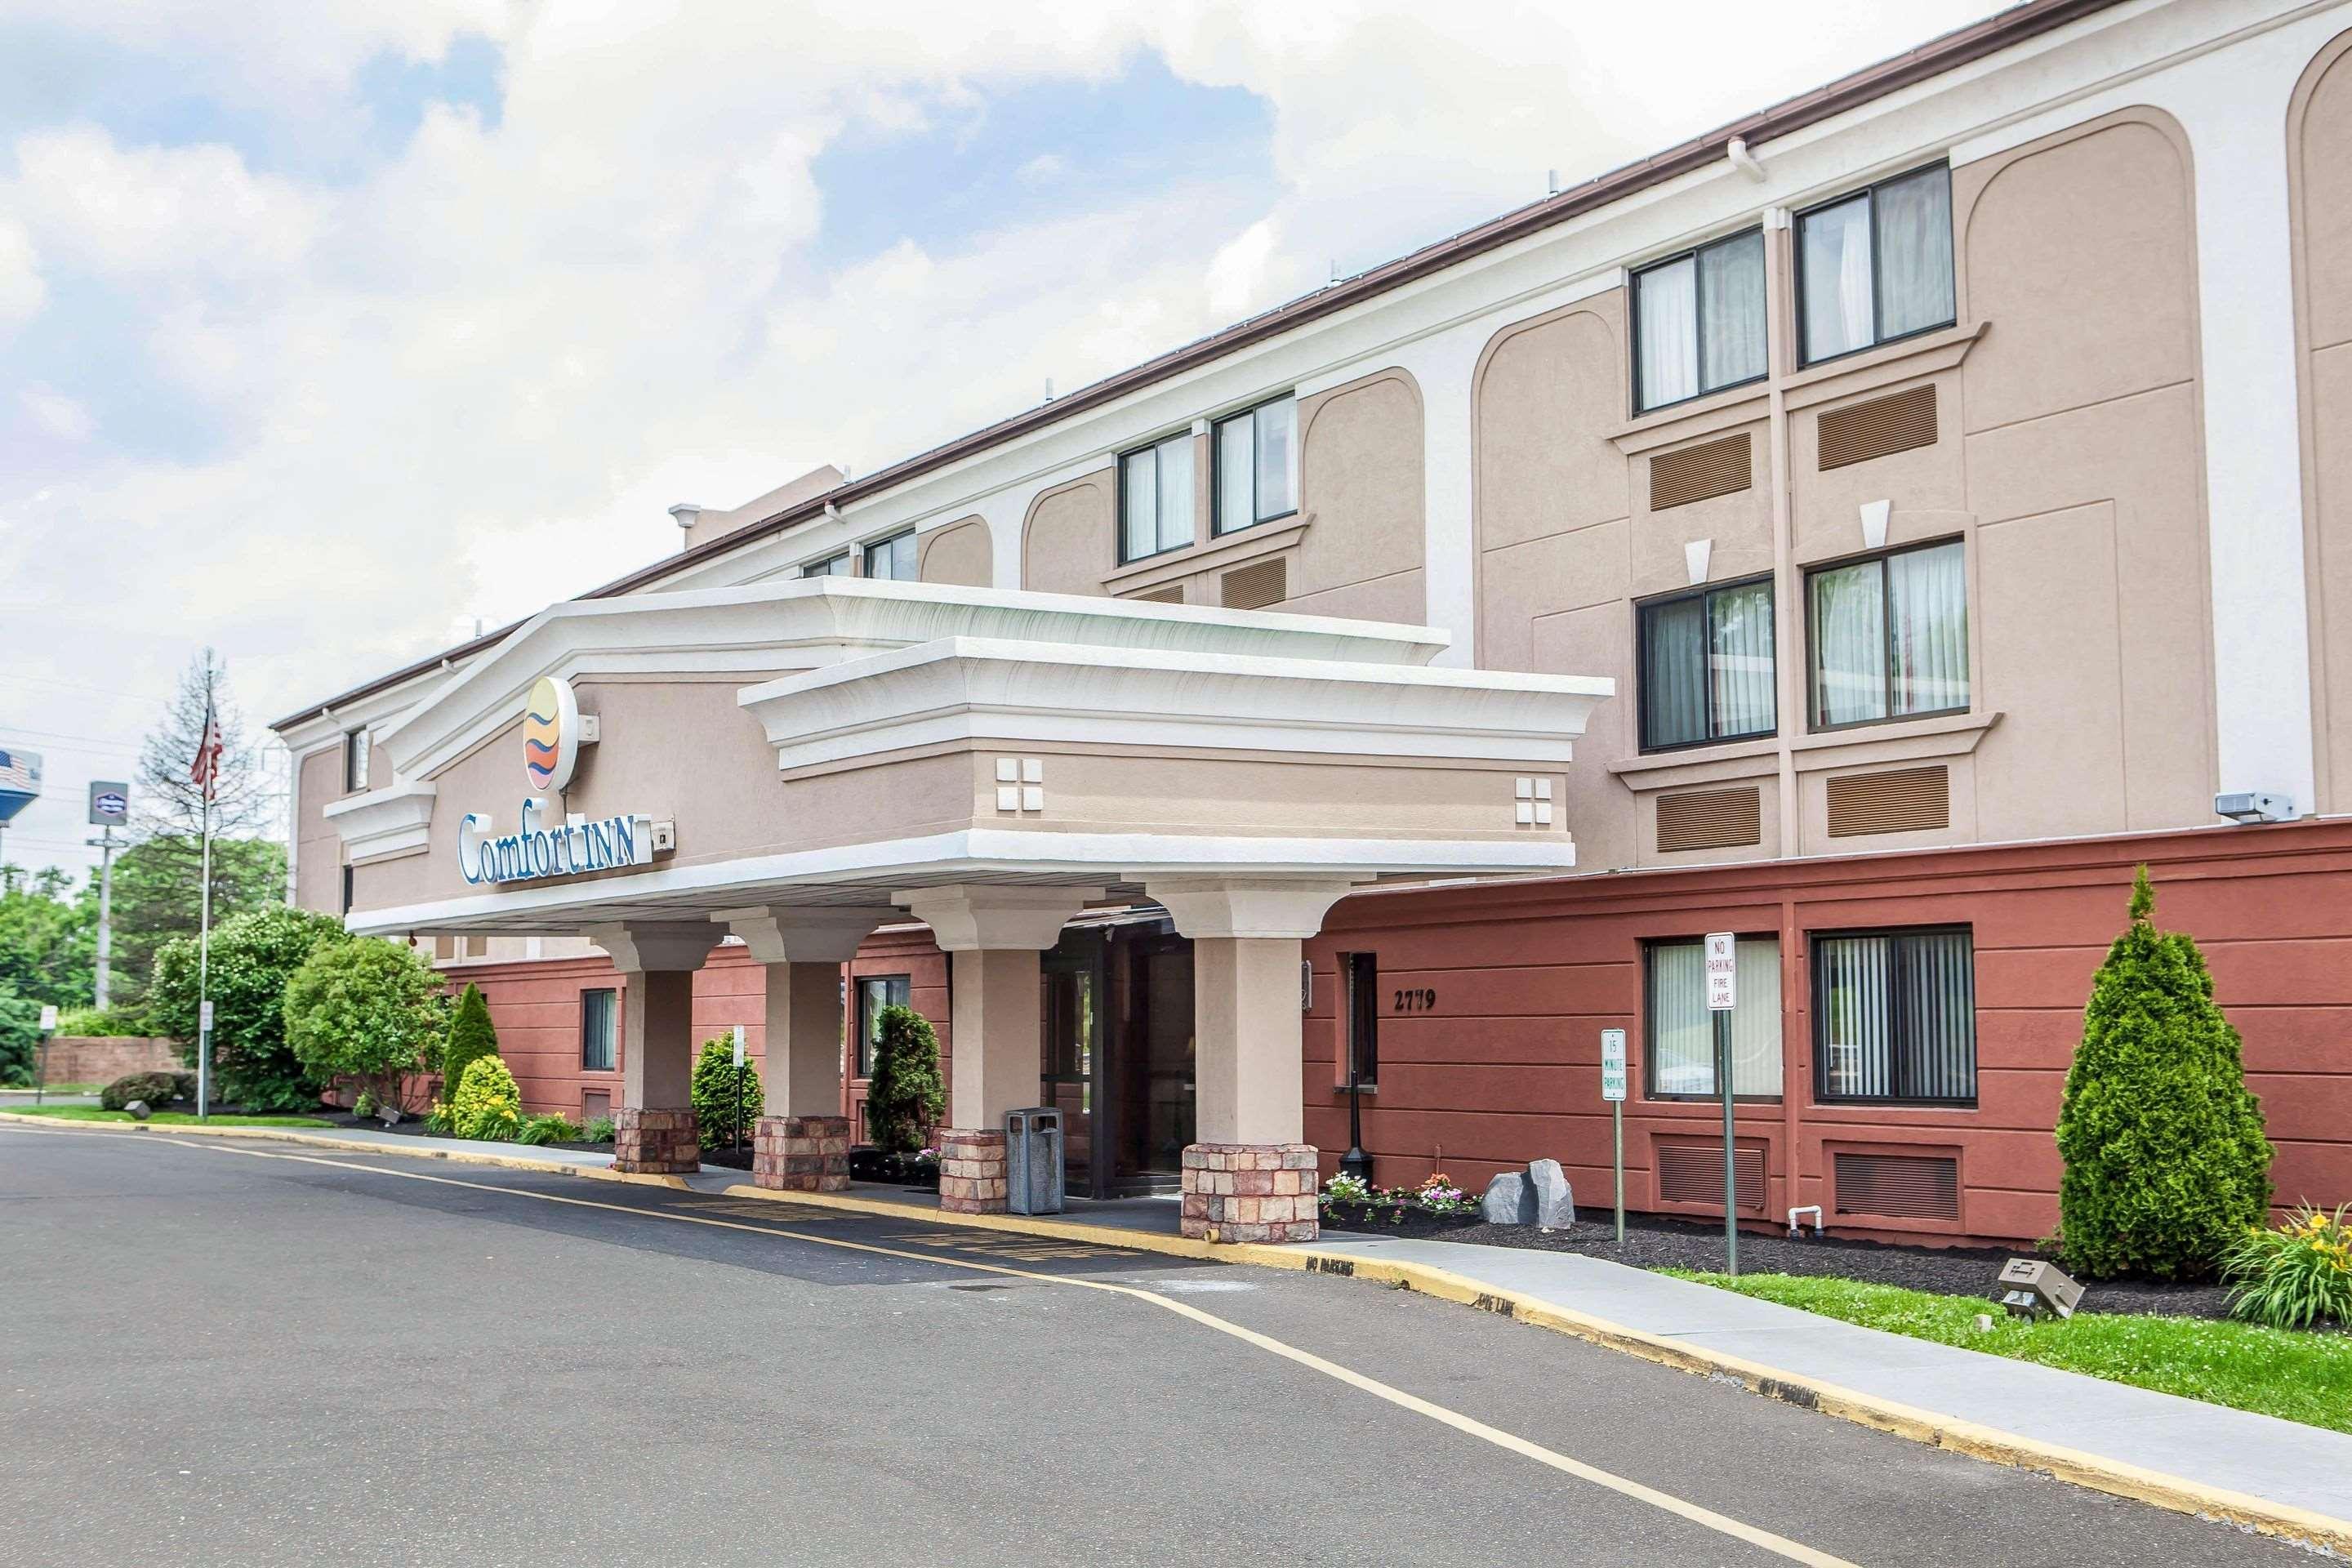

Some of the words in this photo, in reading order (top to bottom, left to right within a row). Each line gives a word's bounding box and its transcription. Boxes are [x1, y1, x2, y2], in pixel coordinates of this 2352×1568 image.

[459, 798, 578, 884] Comfort
[581, 815, 635, 868] INN
[1715, 941, 1725, 954] NO
[1708, 960, 1732, 973] PARKING
[1713, 978, 1728, 988] FIRE
[1394, 988, 1437, 1011] 2779
[1713, 993, 1730, 1003] LANE
[1610, 1040, 1618, 1053] 15
[1604, 1058, 1624, 1071] MINUTE
[1604, 1077, 1624, 1089] PARKING
[1306, 1255, 1318, 1272] NO
[1320, 1258, 1354, 1276] PARKING
